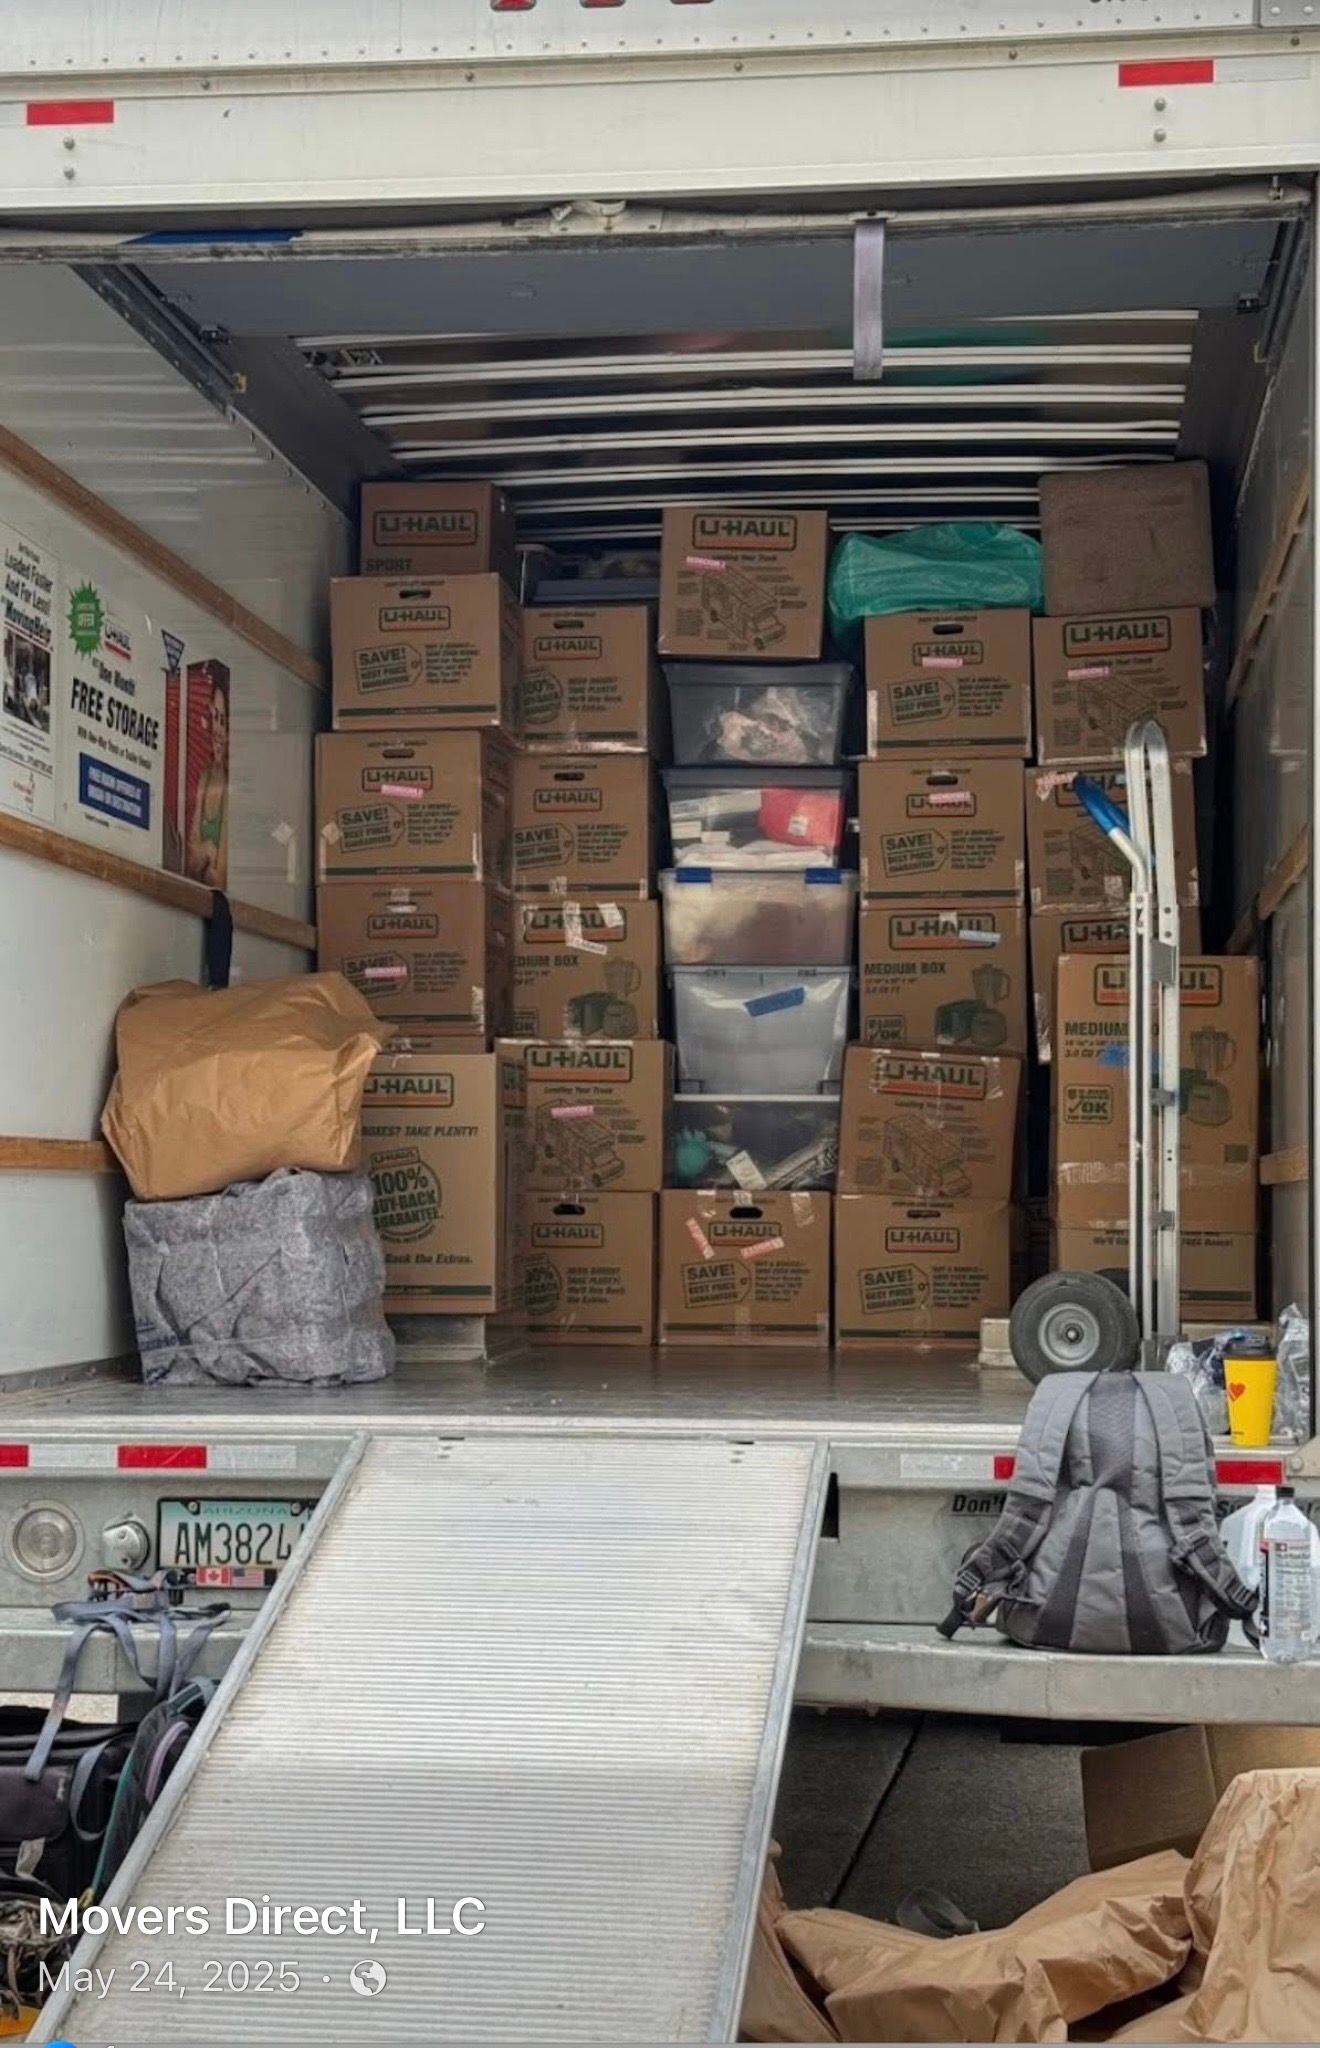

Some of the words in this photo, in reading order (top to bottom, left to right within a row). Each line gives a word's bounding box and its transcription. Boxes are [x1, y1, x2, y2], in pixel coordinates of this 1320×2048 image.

[381, 516, 471, 532] U-HAUL
[701, 519, 790, 536] U-HAUL
[384, 611, 446, 622] U-HAUL
[1070, 621, 1164, 642] U-HAUL
[539, 641, 598, 651] U-HAUL
[918, 645, 978, 657] U-HAUL
[359, 648, 407, 666] SAVE!
[894, 681, 939, 698] SAVE!
[71, 677, 104, 722] FREE
[106, 696, 159, 750] STORAGE
[367, 770, 428, 782] U-HAUL
[539, 791, 598, 803] U-HAUL
[342, 808, 388, 826] SAVE!
[887, 834, 932, 850] SAVE!
[372, 918, 433, 929] U-HAUL
[555, 955, 578, 967] BOX
[865, 962, 917, 975] MEDIUM
[921, 961, 946, 974] BOX
[532, 1051, 625, 1067] U-HAUL
[883, 1062, 980, 1086] U-HAUL
[1081, 1101, 1108, 1113] OK
[405, 1126, 432, 1136] TAKE
[371, 1166, 428, 1196] 100%
[537, 1228, 599, 1238] U-HAUL
[713, 1226, 777, 1237] U-HAUL
[890, 1231, 954, 1243] U-HAUL
[687, 1263, 735, 1280] SAVE!
[864, 1269, 912, 1286] SAVE!
[203, 1505, 288, 1515] ARIZONA
[175, 1522, 305, 1564] AM3824
